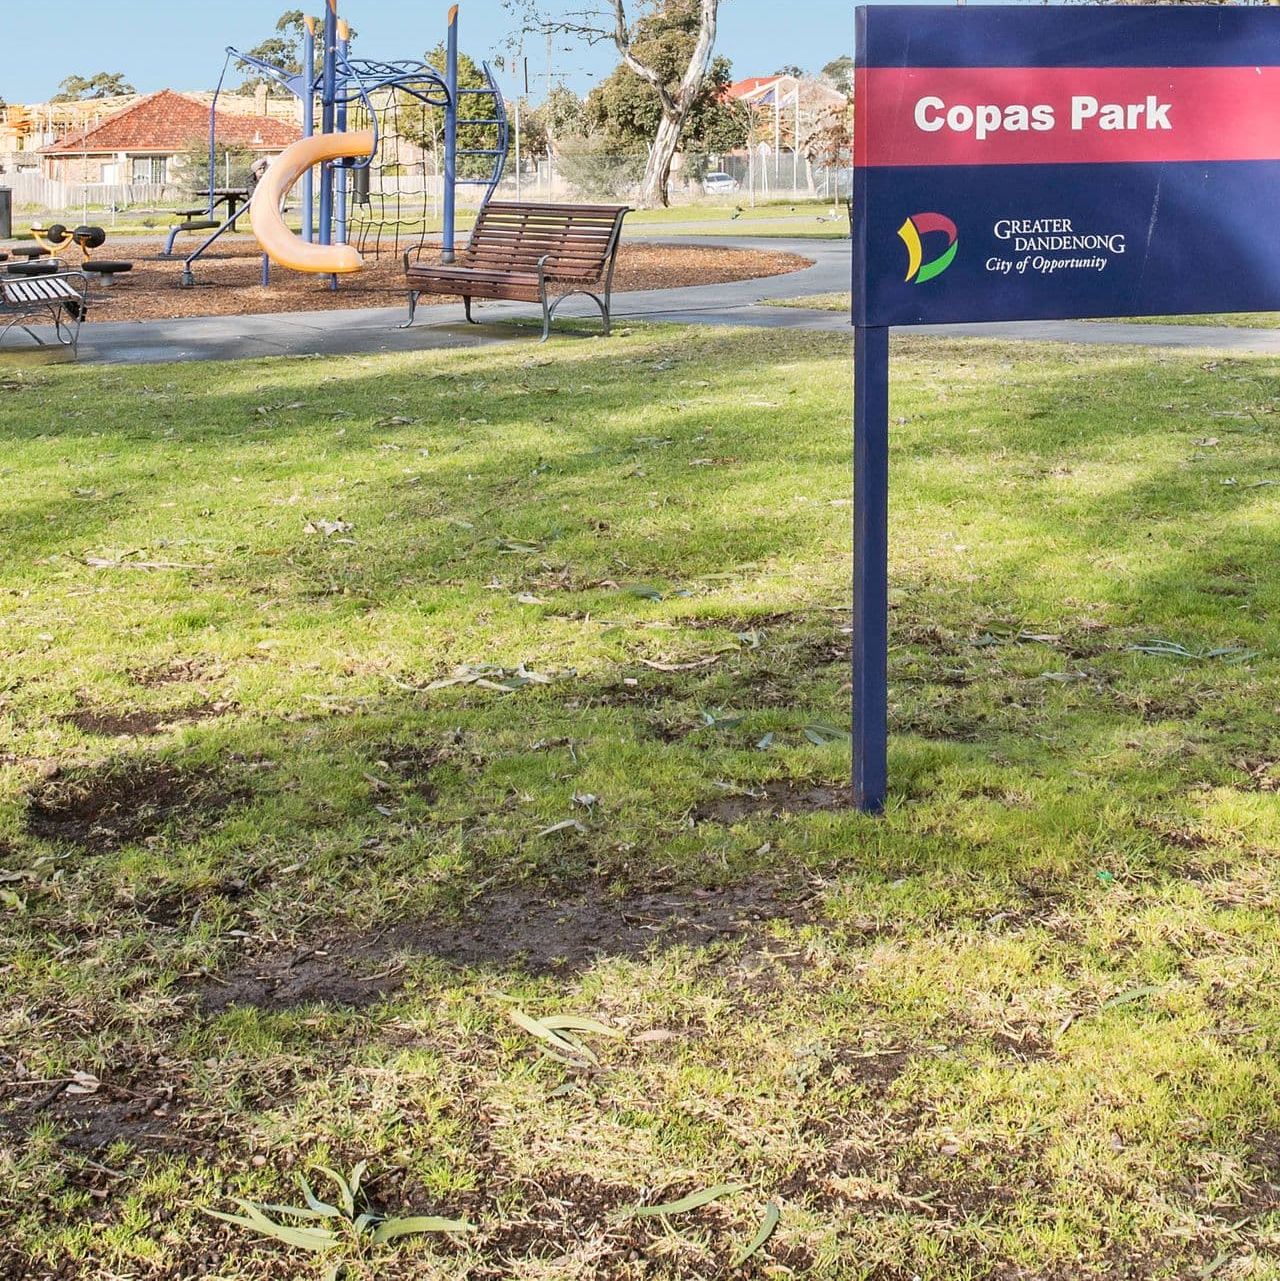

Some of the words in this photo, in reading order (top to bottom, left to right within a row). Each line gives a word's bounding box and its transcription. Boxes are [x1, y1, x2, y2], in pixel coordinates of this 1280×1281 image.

[914, 96, 1055, 140] Copas
[1071, 95, 1172, 130] Park
[994, 219, 1073, 239] GREATER
[1014, 234, 1126, 253] DANDENONG
[985, 257, 1013, 274] City
[1015, 256, 1032, 274] of
[1032, 255, 1107, 273] Opportunity
